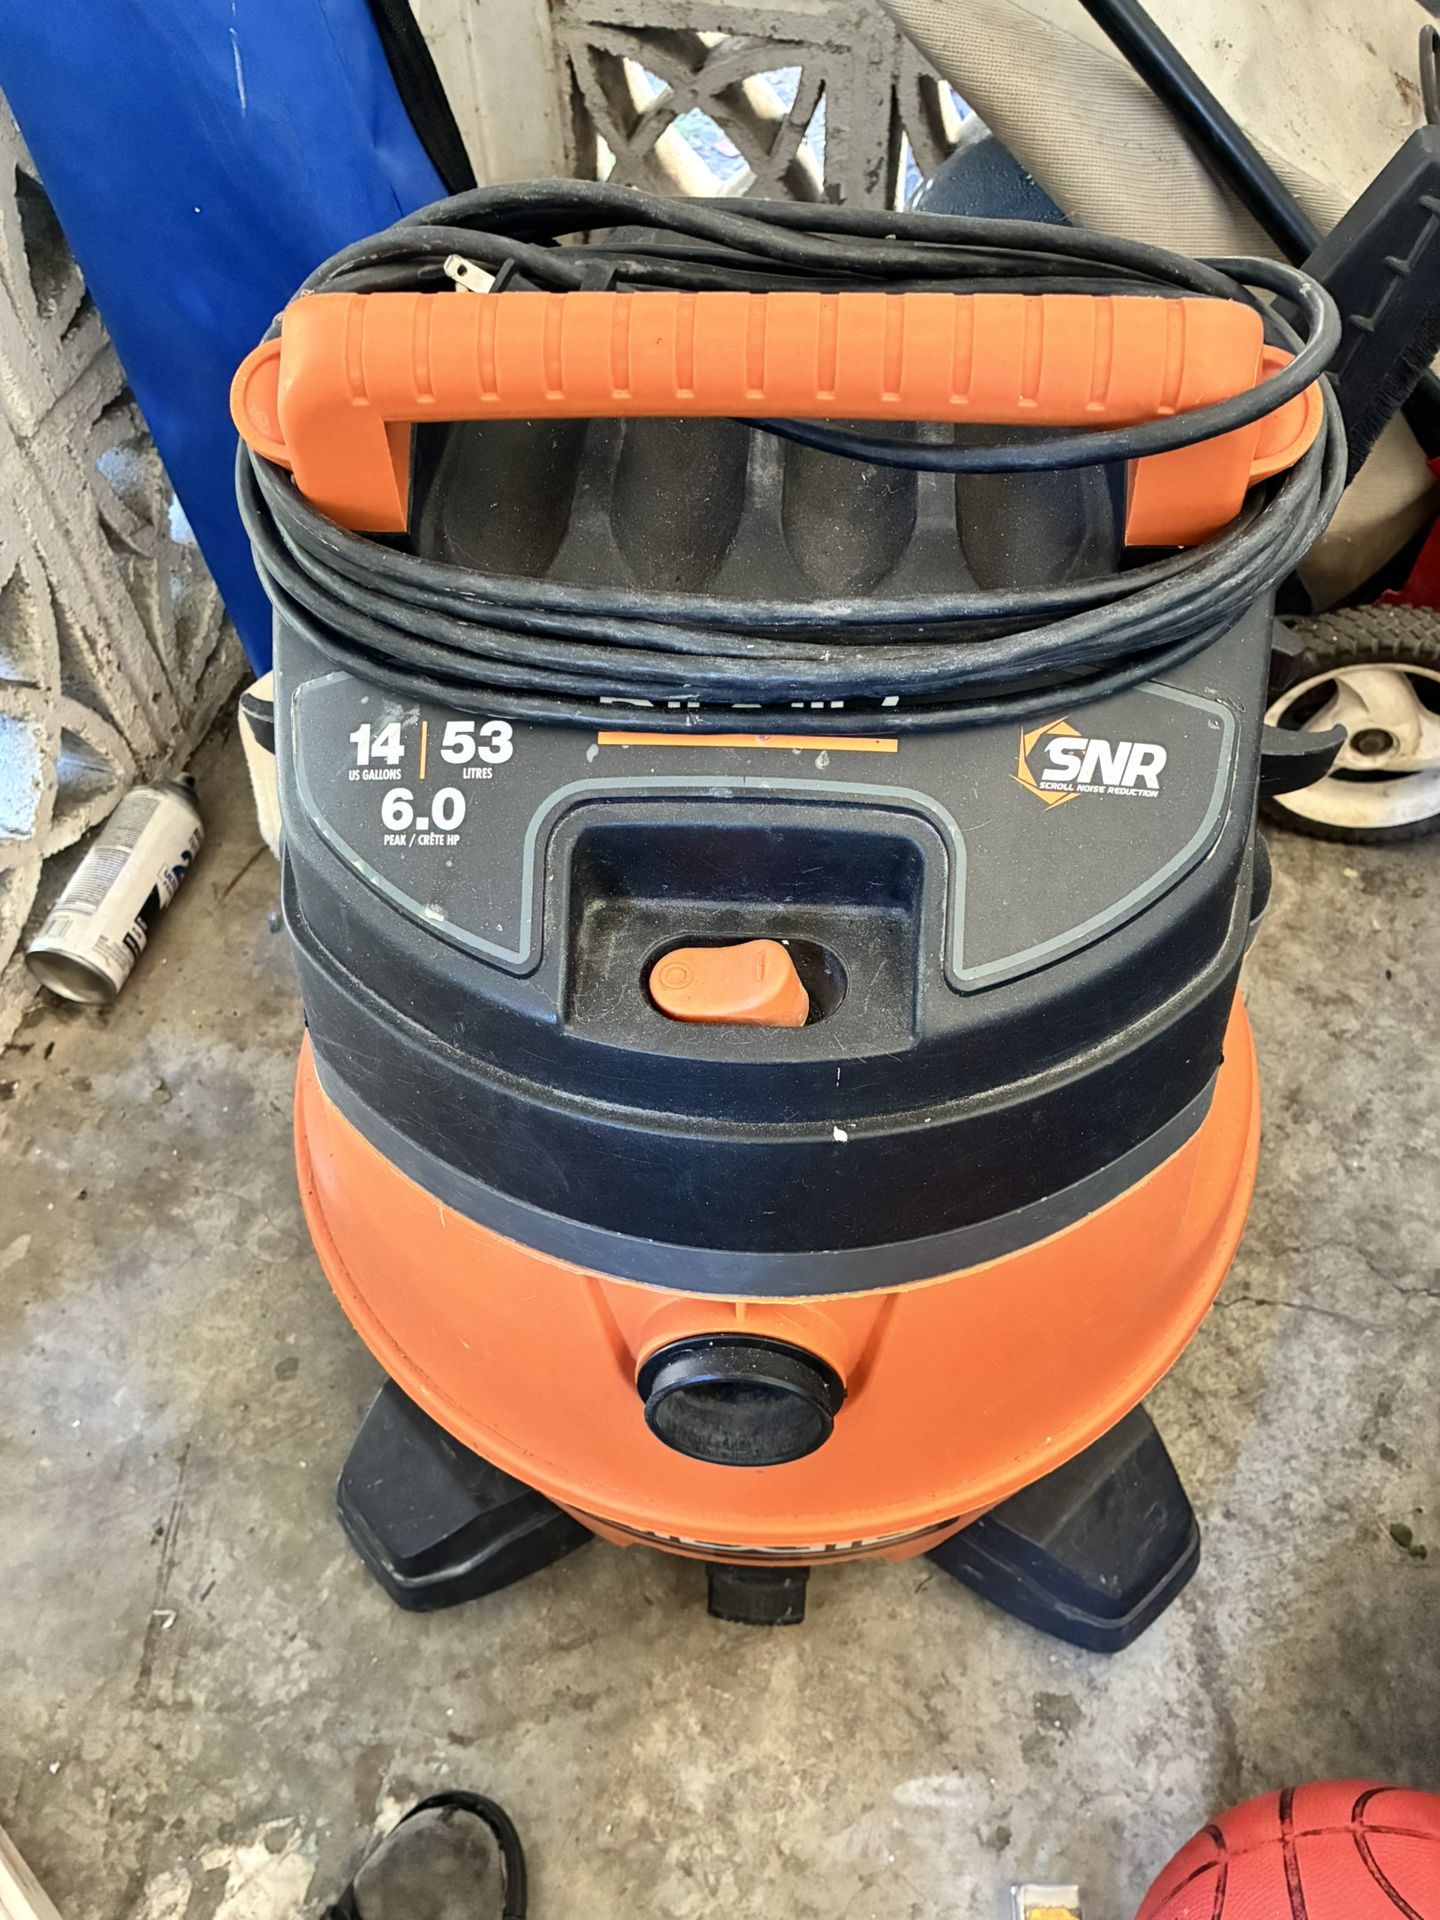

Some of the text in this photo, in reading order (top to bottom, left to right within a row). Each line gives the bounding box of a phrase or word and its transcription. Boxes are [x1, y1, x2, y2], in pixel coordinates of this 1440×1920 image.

[350, 722, 405, 766] 14
[440, 720, 514, 765] 53
[348, 768, 402, 781] US GALLONS
[463, 767, 493, 780] LITRES
[1041, 737, 1167, 789] SNR
[1039, 782, 1159, 797] SCROLL NOISE REDUCTION
[381, 787, 466, 831] 6.0
[383, 832, 460, 848] PEAK / CRÊTE HP
